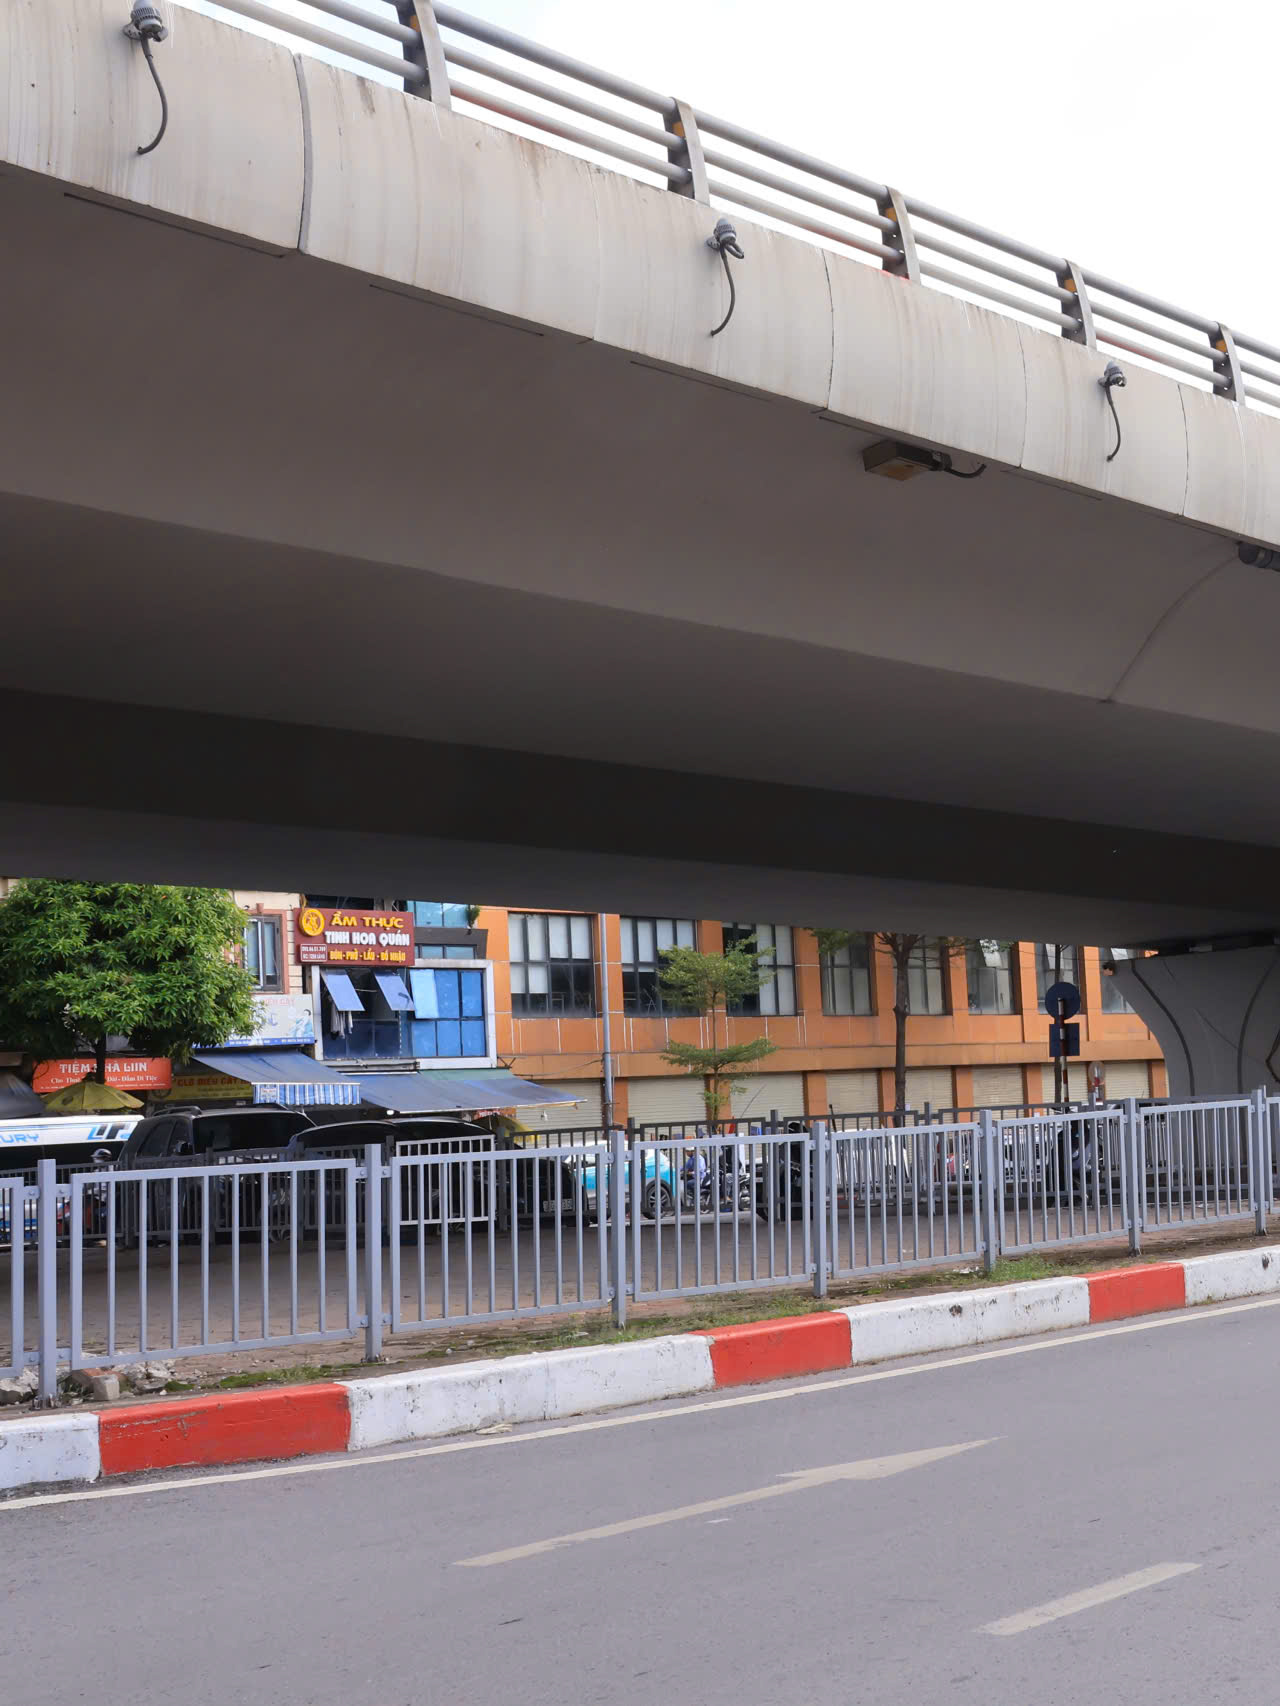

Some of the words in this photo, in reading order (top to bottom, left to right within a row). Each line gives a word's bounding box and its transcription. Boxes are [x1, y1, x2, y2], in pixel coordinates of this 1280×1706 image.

[331, 911, 358, 926] ẨM
[363, 917, 404, 930] THỰC
[325, 931, 350, 944] TINH
[352, 932, 377, 945] HOA
[379, 930, 410, 947] QUÁN
[59, 1061, 90, 1075] TIỆM
[0, 1133, 39, 1144] URY
